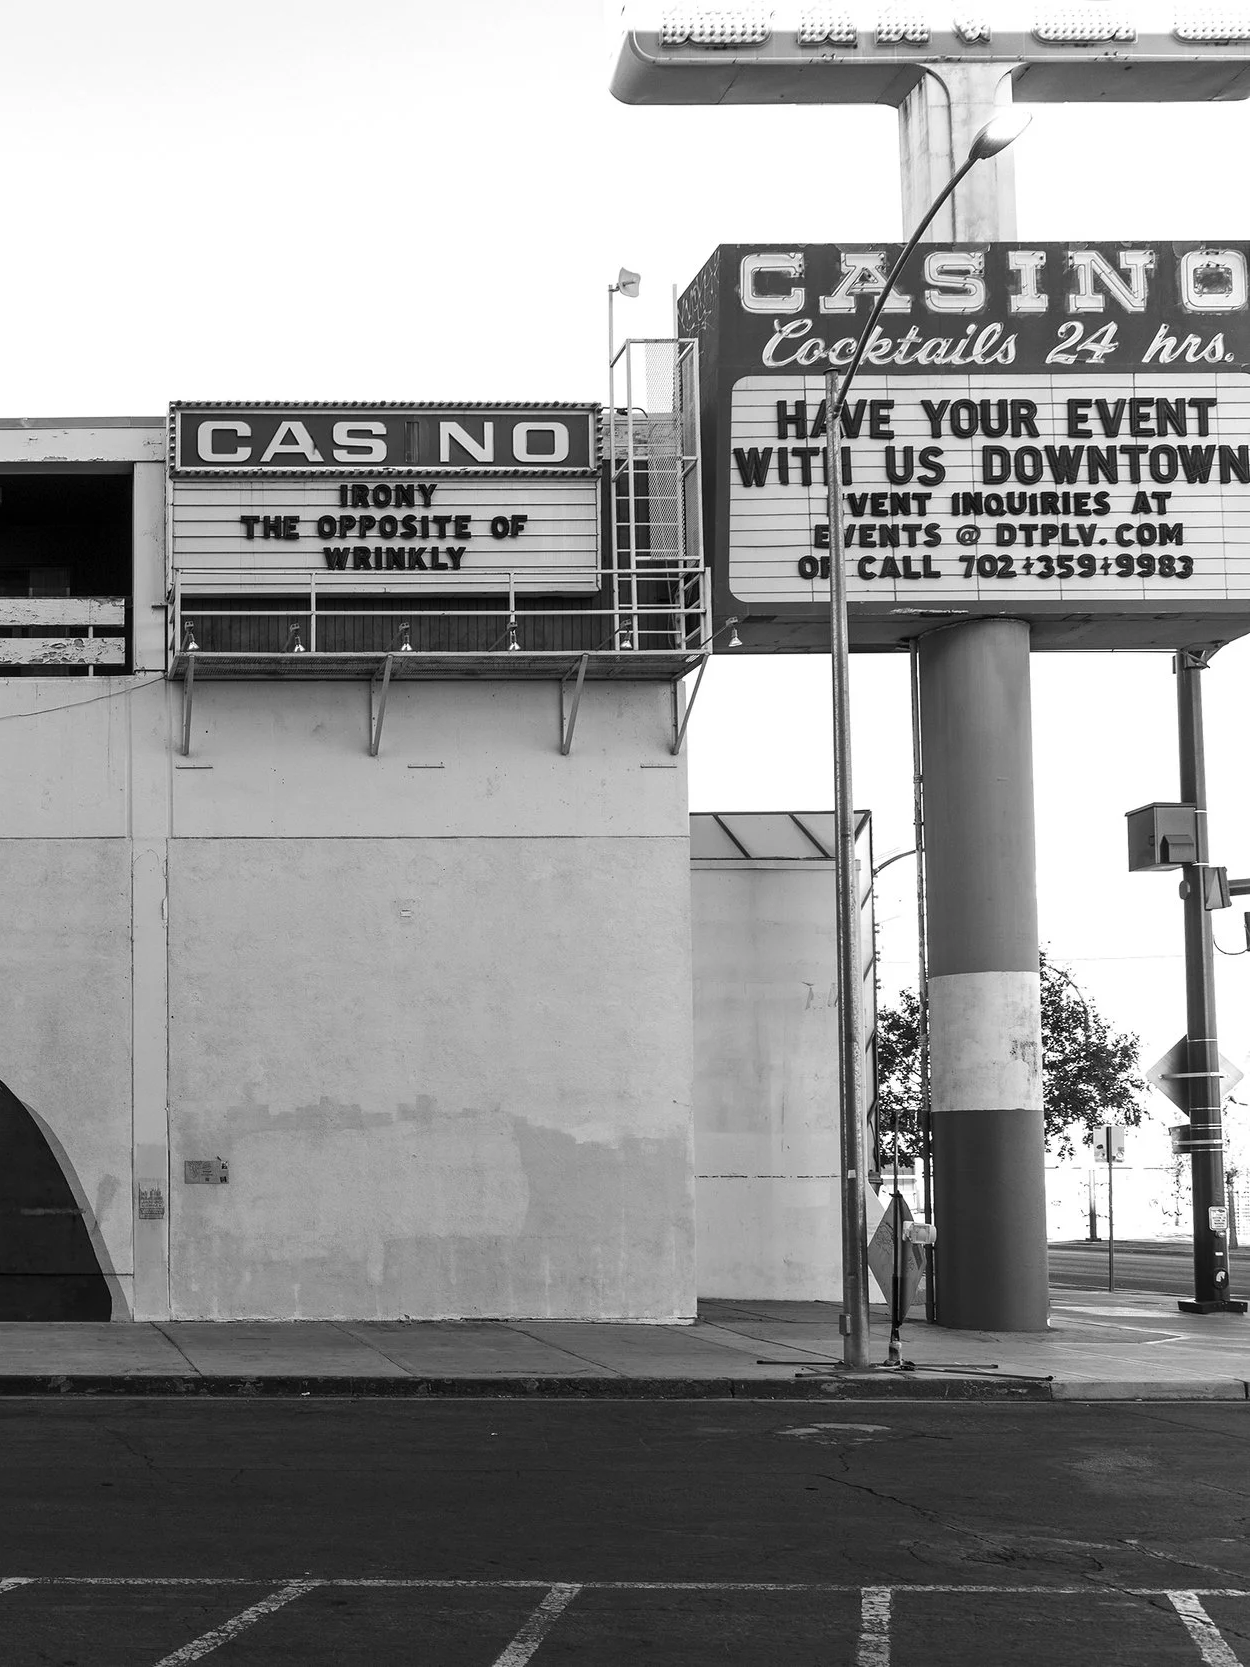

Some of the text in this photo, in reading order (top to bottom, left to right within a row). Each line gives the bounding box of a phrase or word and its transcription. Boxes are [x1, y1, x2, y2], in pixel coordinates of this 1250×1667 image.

[740, 248, 1249, 314] CASINO
[762, 318, 1235, 368] Cocktails 24 hrs.
[777, 397, 1218, 440] HAVE YOUR EVENT
[197, 420, 569, 463] CASINO
[885, 445, 946, 486] US
[982, 444, 1250, 485] DOWNTOWN
[339, 483, 438, 509] IRONY
[827, 491, 1173, 517] VENT INQUIRIES AT
[240, 514, 528, 540] THE OPPOSITE OF
[956, 525, 982, 545] @
[323, 547, 467, 571] WRINKLY
[857, 555, 941, 580] CALL
